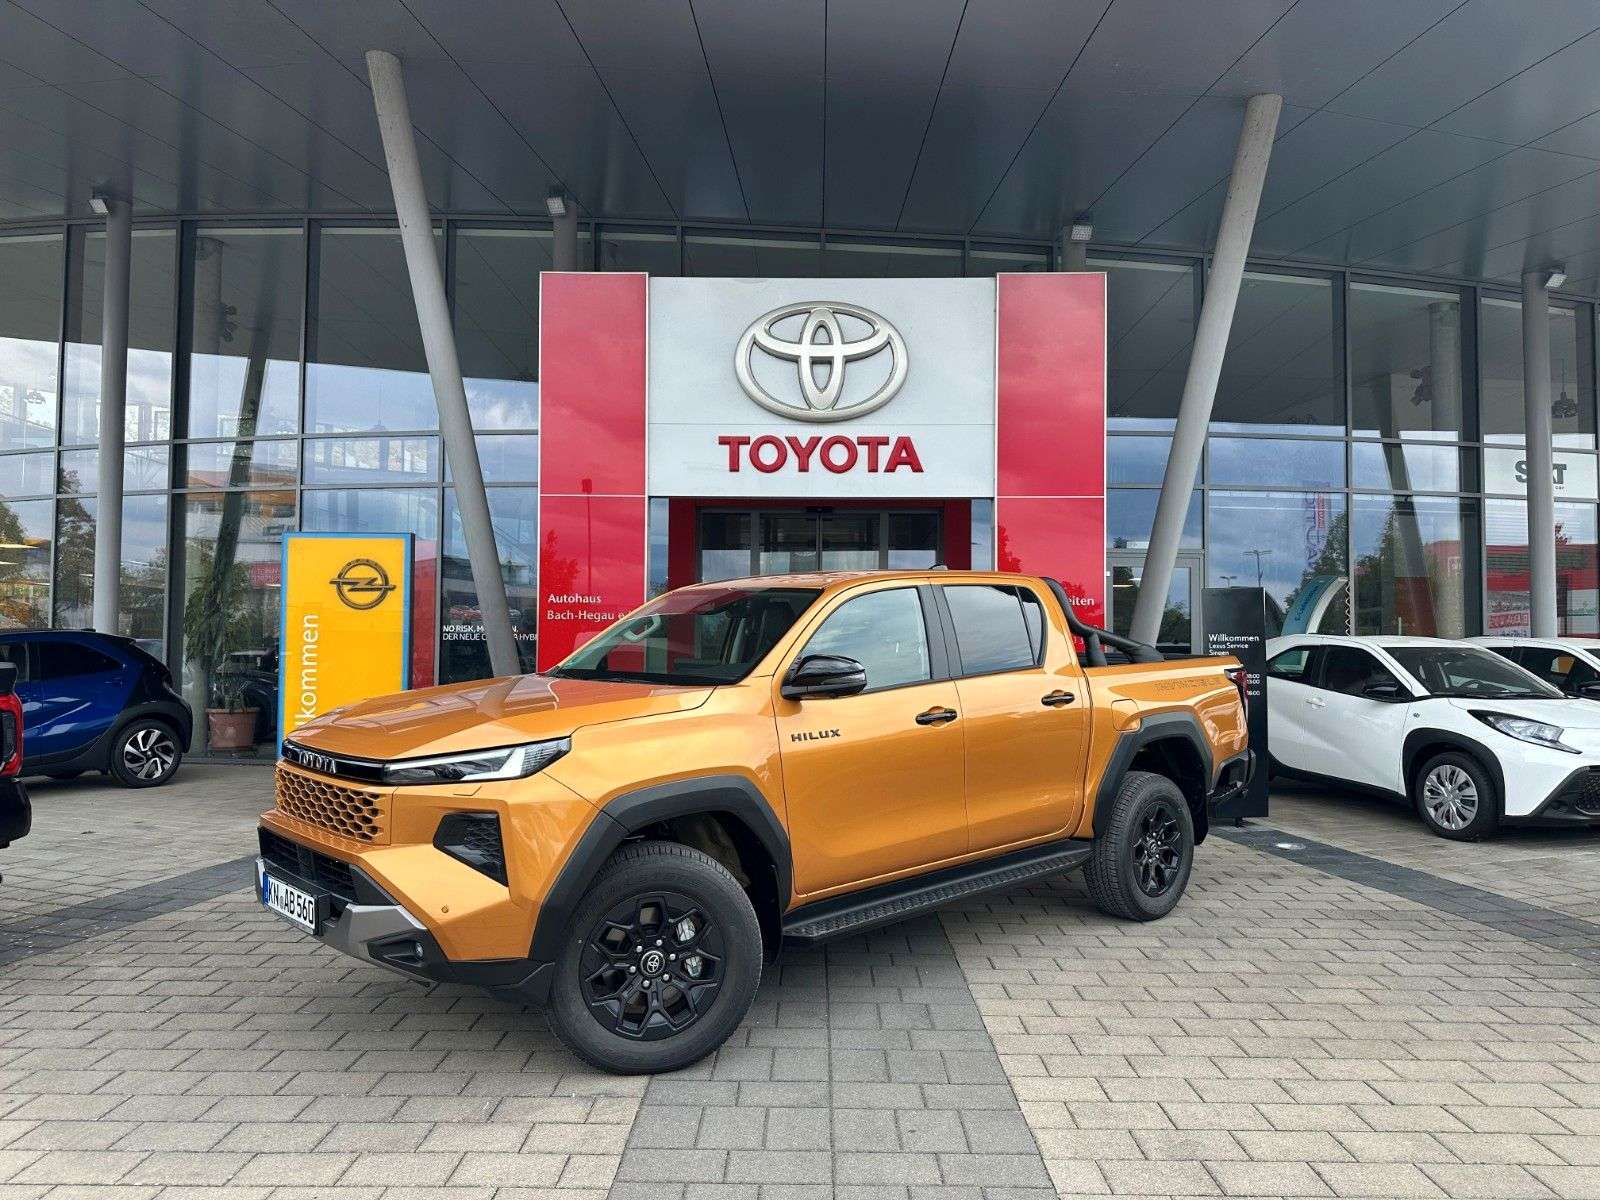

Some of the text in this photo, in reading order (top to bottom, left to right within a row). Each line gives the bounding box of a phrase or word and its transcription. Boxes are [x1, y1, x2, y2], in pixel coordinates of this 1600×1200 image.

[718, 435, 924, 474] TOYOTA
[1514, 460, 1567, 484] ST
[548, 593, 602, 604] Autohaus
[547, 610, 615, 622] Bach-Hegau
[1208, 633, 1260, 642] Willkommen
[791, 728, 841, 742] HILUX
